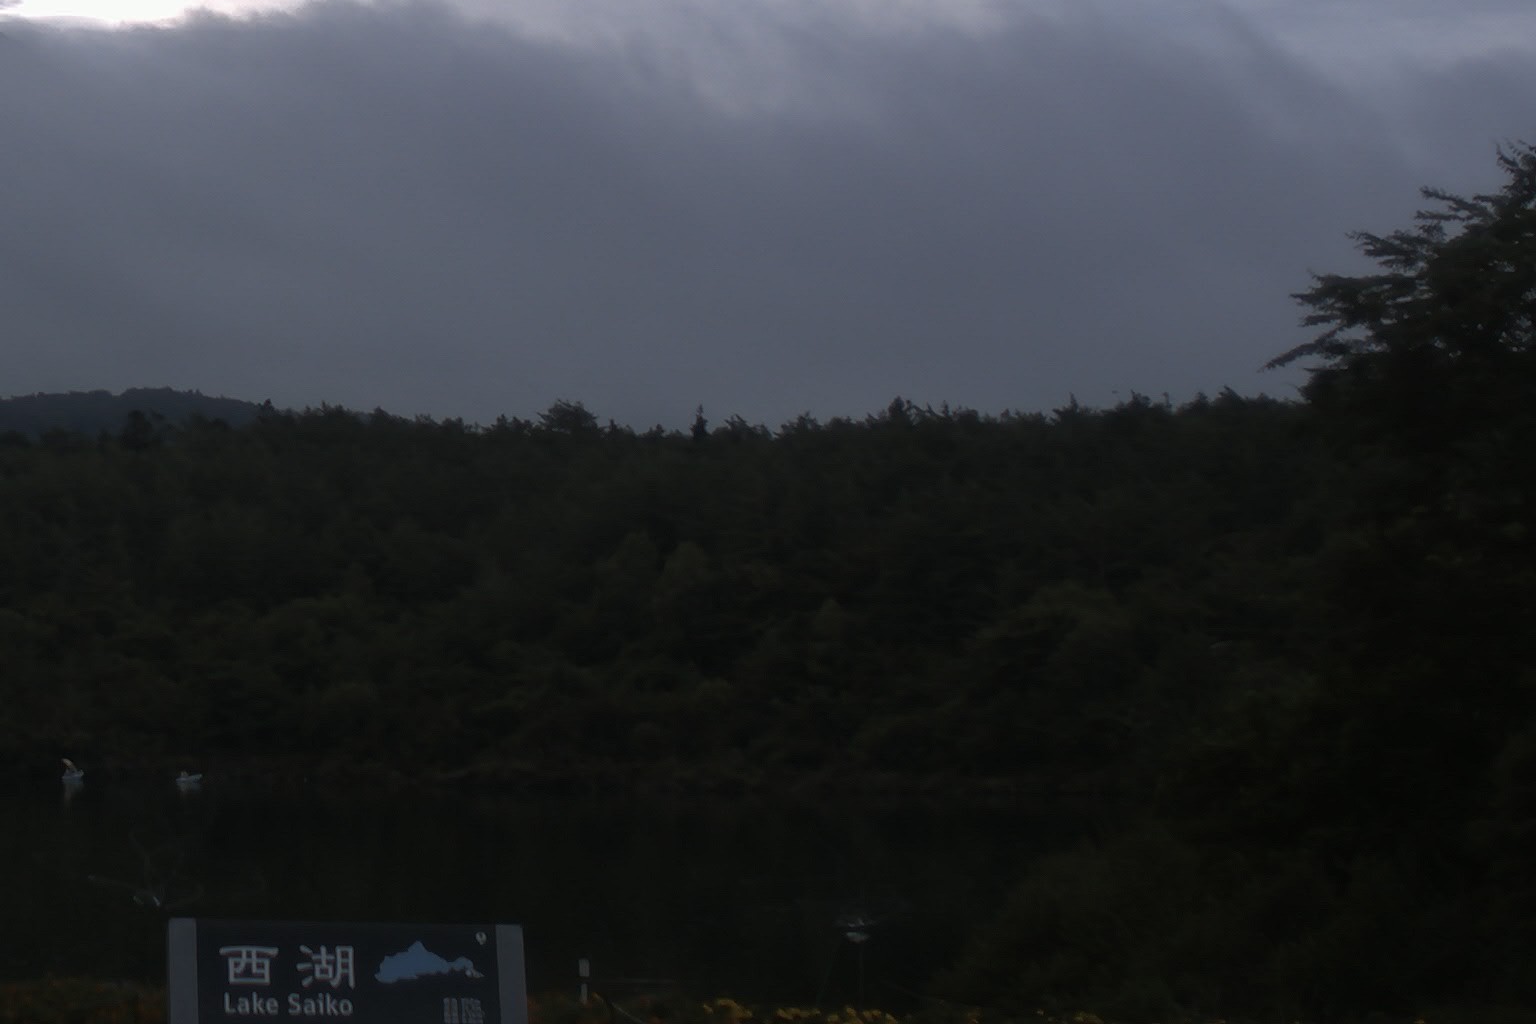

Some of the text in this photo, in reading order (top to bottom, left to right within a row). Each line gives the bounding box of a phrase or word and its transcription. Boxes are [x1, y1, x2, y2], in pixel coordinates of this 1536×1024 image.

[219, 944, 357, 989] 西湖
[224, 991, 354, 1016] Lake Saiko
